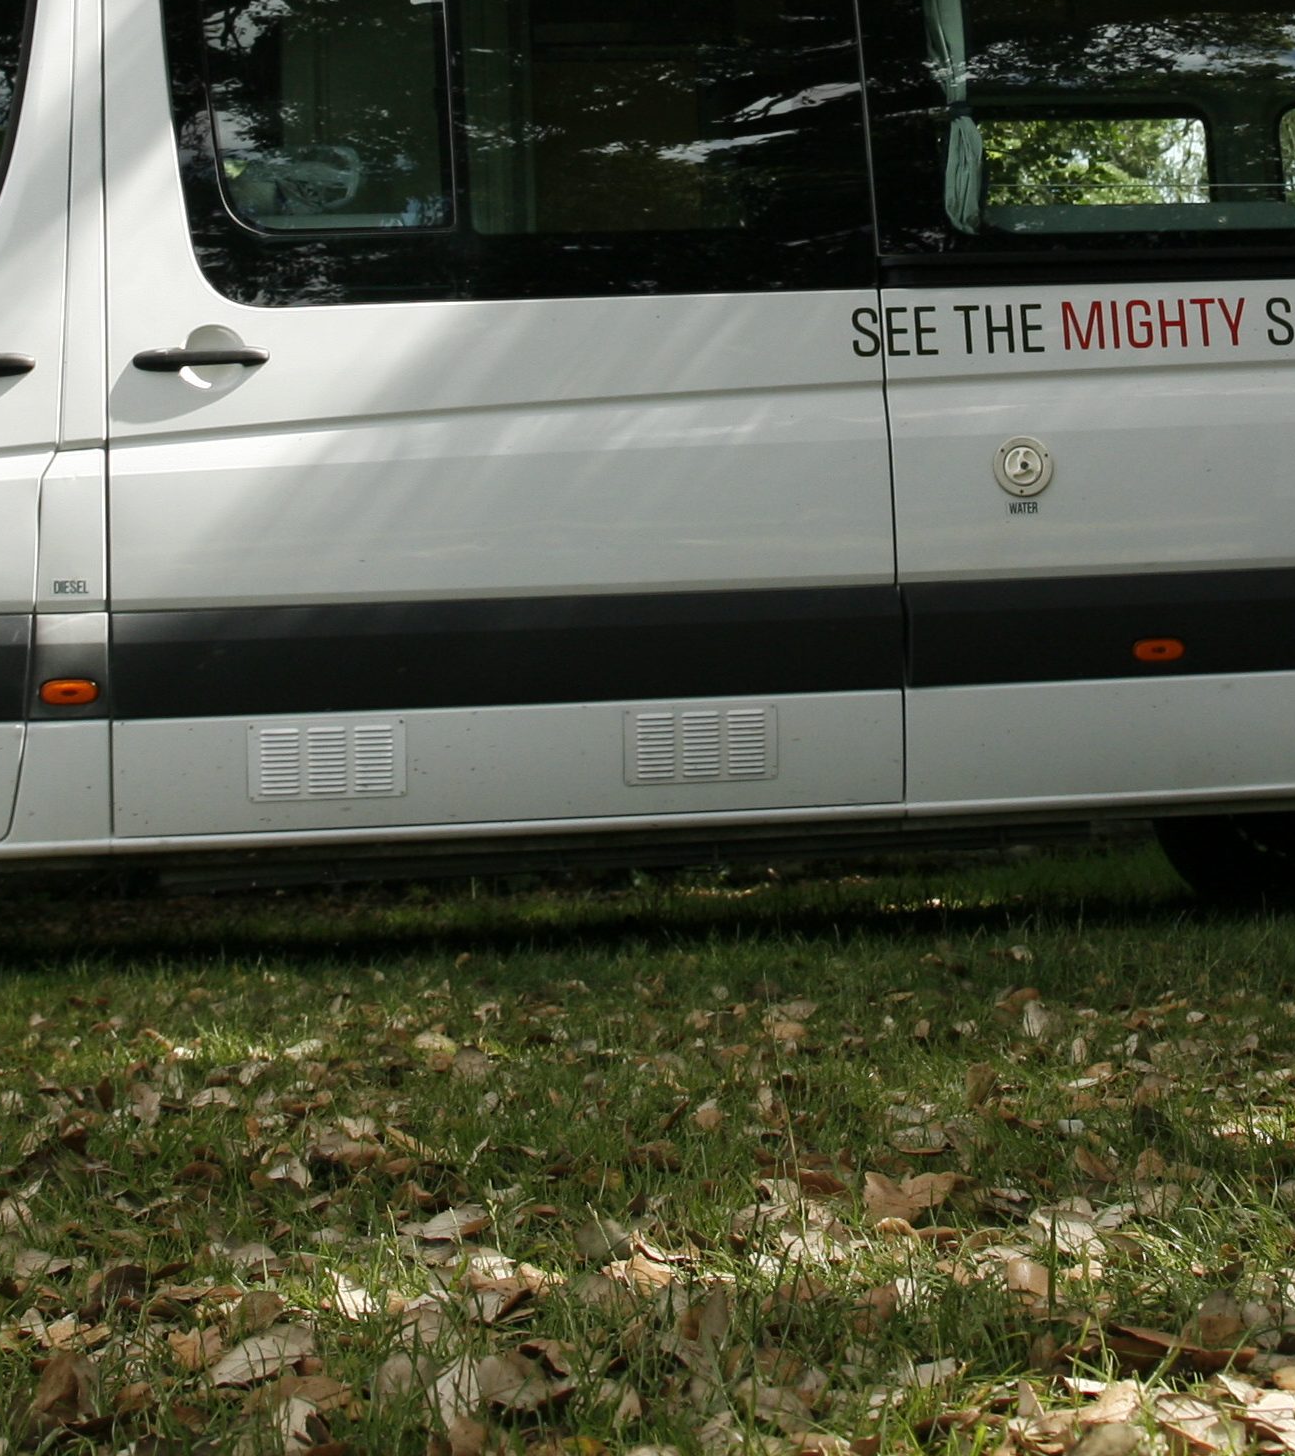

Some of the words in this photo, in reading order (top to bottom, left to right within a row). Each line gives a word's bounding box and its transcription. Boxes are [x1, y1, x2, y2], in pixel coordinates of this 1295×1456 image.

[852, 305, 939, 357] SEE
[954, 303, 1045, 354] THE
[1061, 298, 1246, 350] MIGHTY
[1008, 501, 1038, 514] WATER
[53, 580, 89, 594] DIESEL
